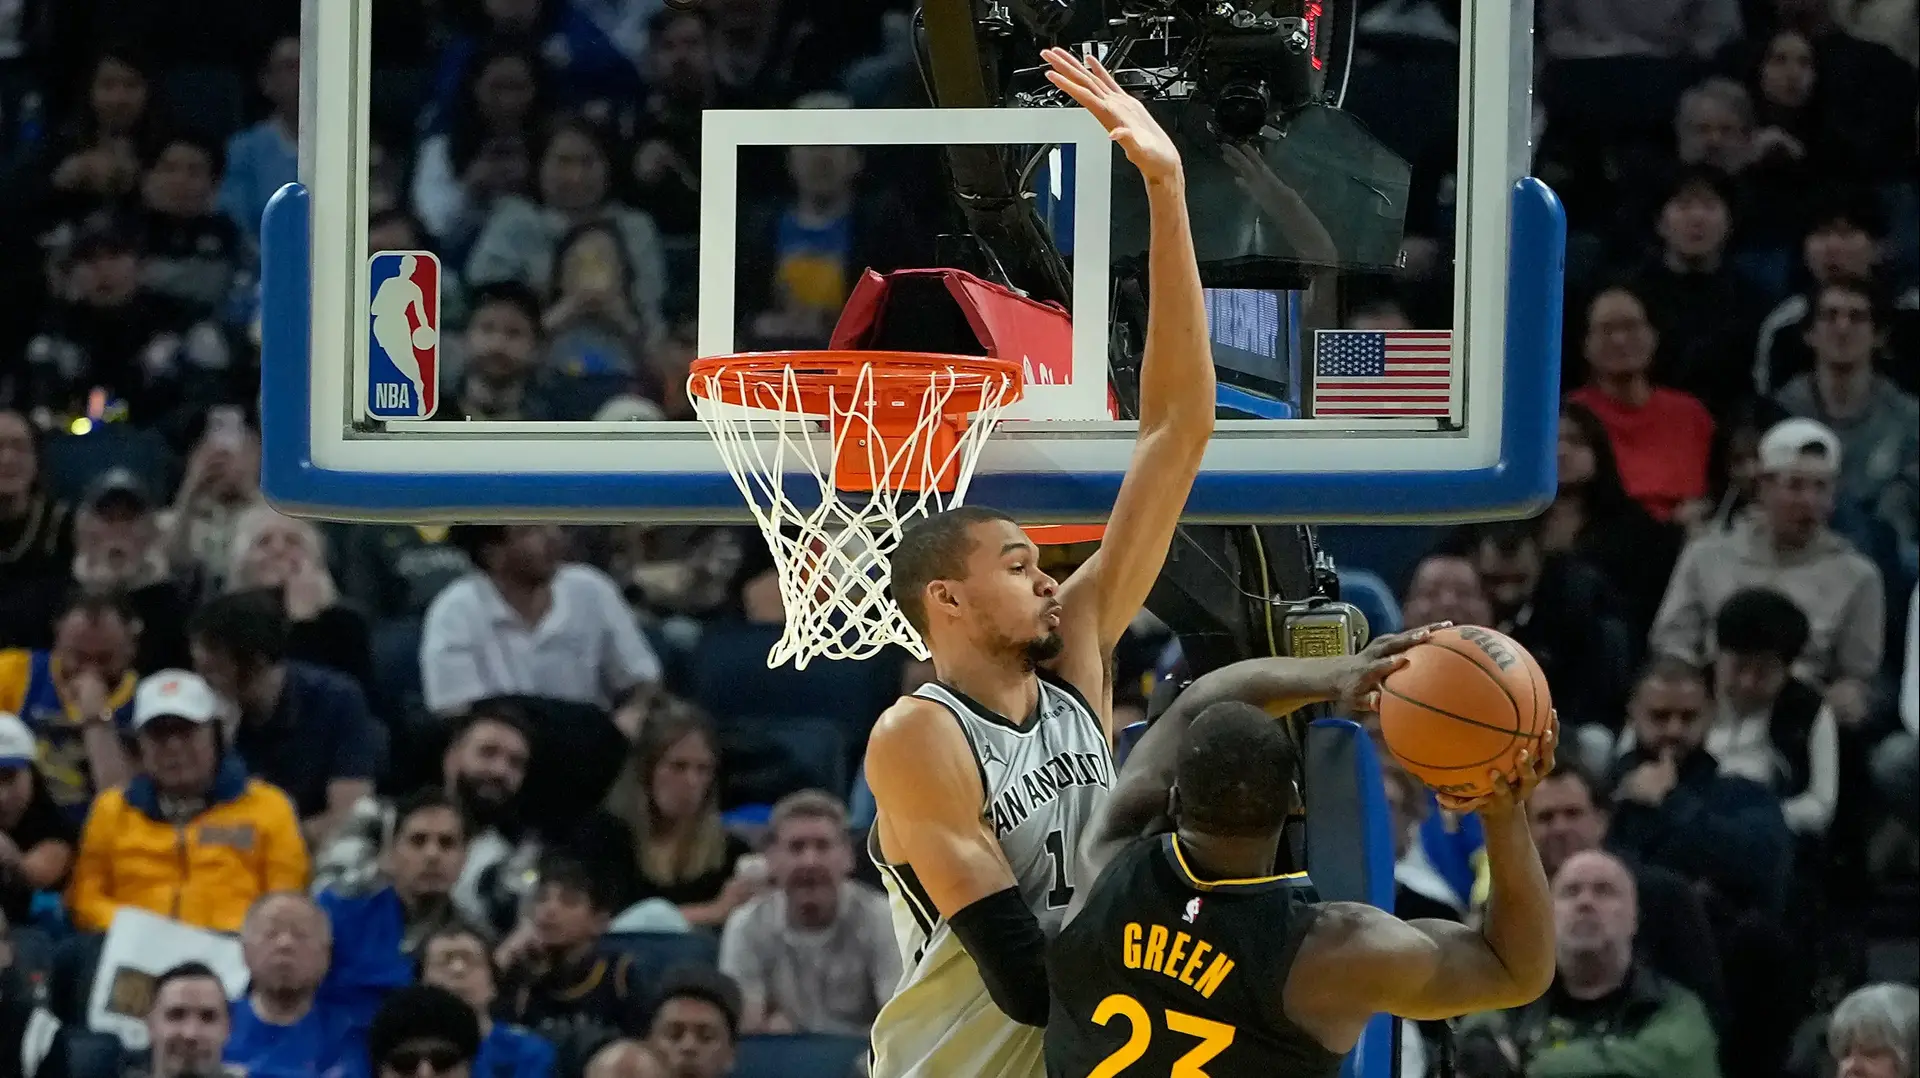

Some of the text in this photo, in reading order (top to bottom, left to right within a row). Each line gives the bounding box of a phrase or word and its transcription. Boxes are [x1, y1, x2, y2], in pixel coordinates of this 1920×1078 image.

[376, 383, 410, 409] NBA
[984, 785, 1030, 840] AN
[1043, 827, 1076, 911] 1
[1123, 922, 1235, 999] GREEN
[1086, 993, 1236, 1078] 23
